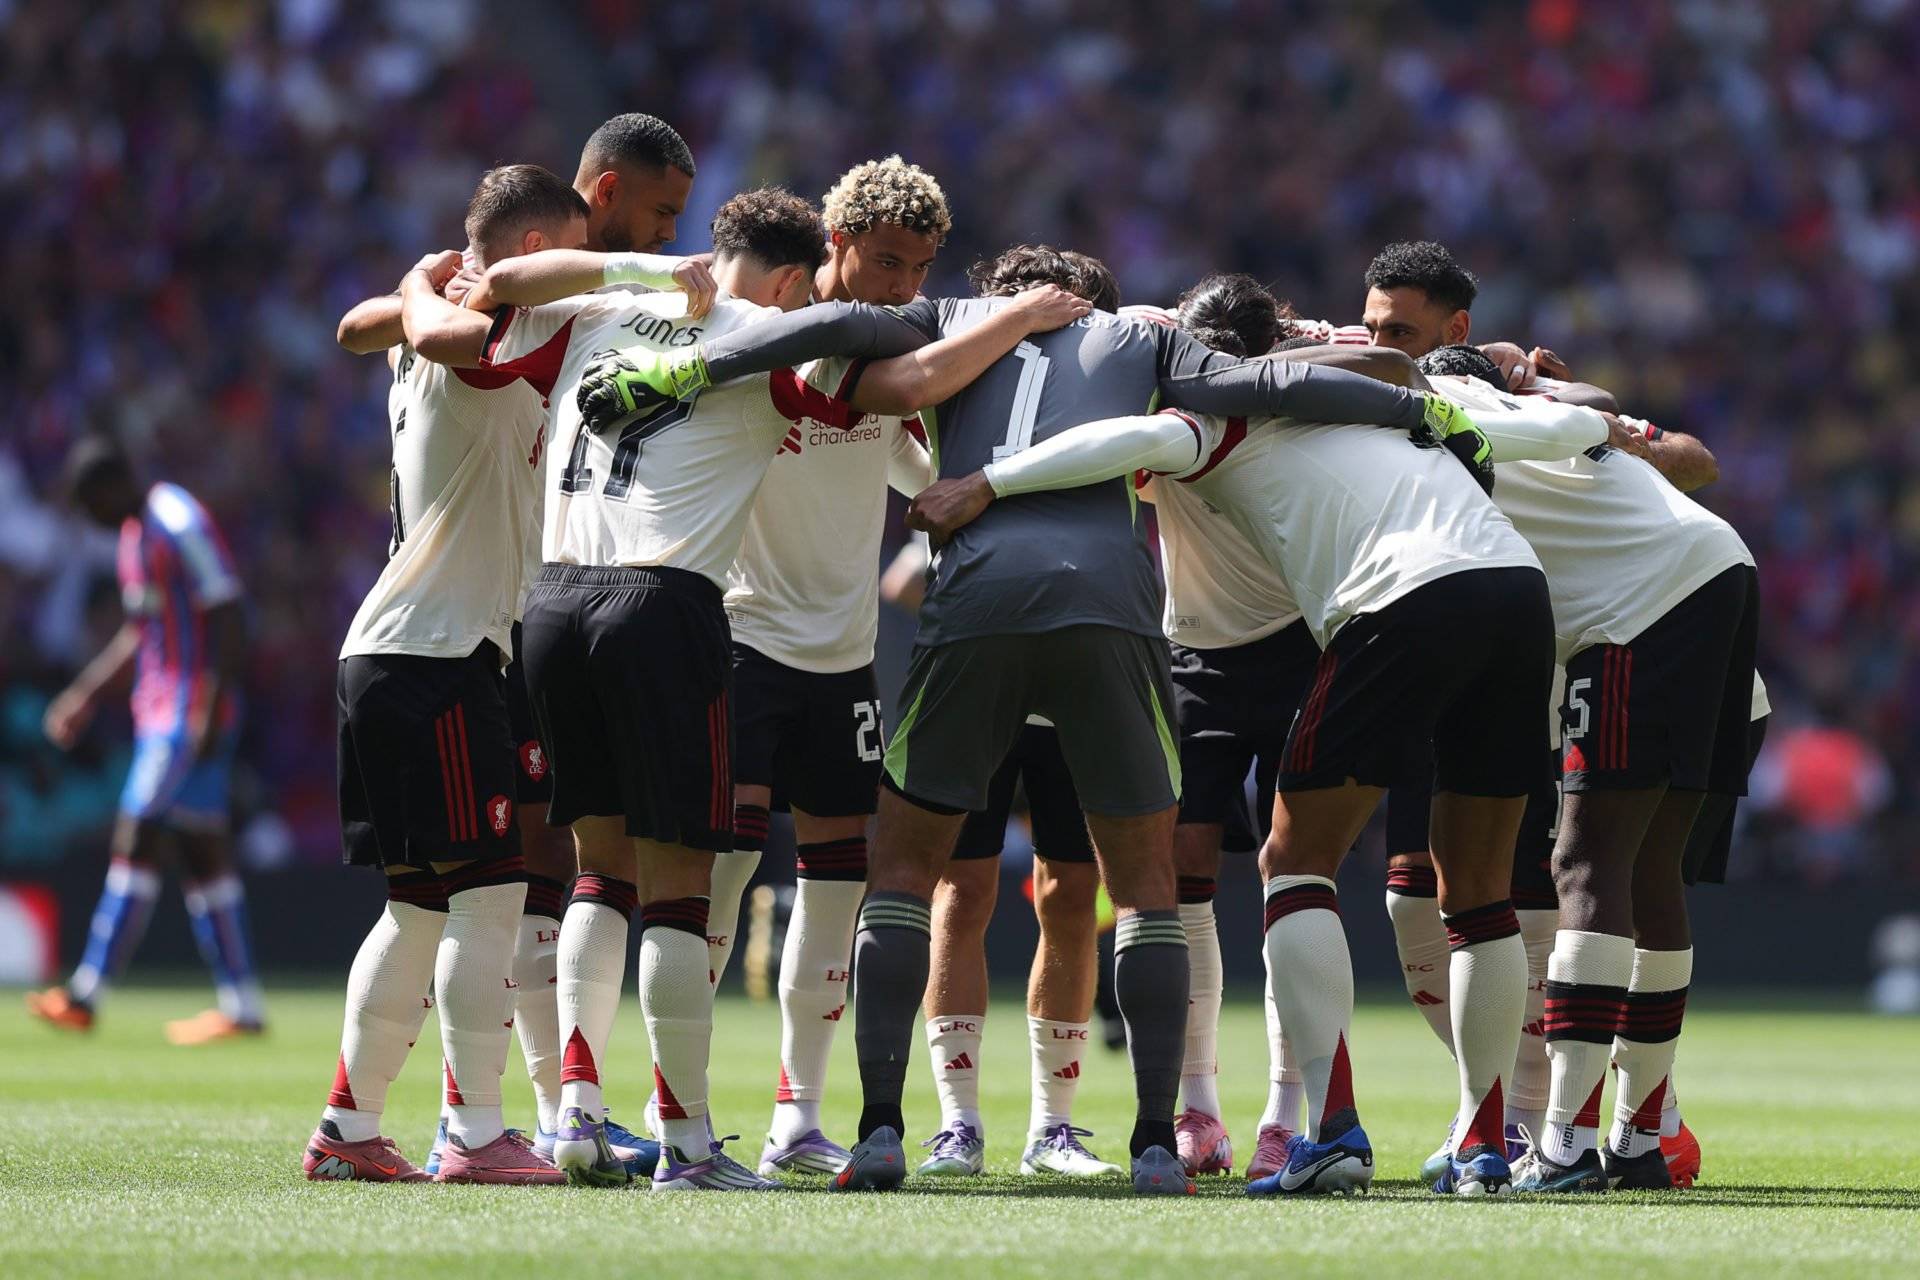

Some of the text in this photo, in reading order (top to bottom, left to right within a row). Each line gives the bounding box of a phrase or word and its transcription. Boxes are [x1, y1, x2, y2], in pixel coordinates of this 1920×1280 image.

[809, 423, 881, 446] chartered
[992, 340, 1050, 466] 1
[558, 388, 699, 502] 17
[853, 699, 881, 762] 2
[1558, 677, 1592, 740] 5
[938, 1020, 976, 1033] LFC
[1052, 1027, 1088, 1041] LFC
